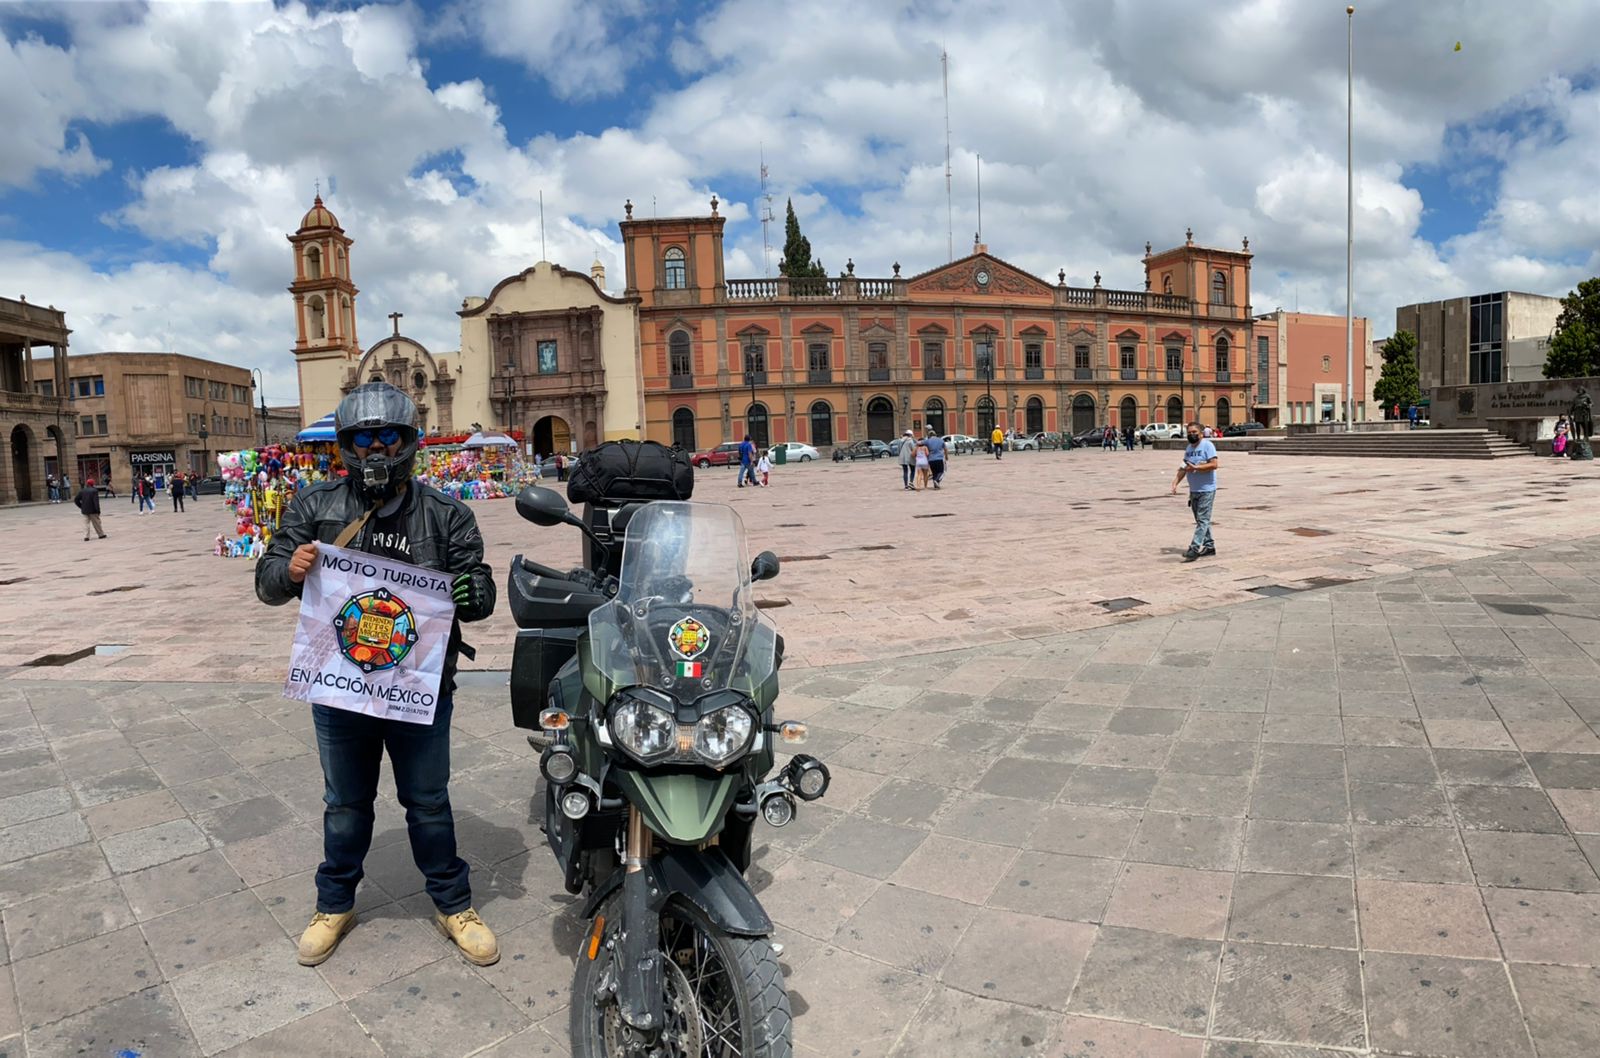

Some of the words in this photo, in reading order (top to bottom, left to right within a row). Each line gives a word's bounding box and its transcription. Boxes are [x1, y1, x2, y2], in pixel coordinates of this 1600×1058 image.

[131, 453, 174, 462] PARISINA
[322, 554, 377, 577] MOTO
[382, 567, 448, 593] TURISTA
[378, 590, 388, 598] N
[290, 668, 311, 683] EN
[313, 672, 374, 696] ACCIÓN
[377, 685, 434, 707] MÉXICO
